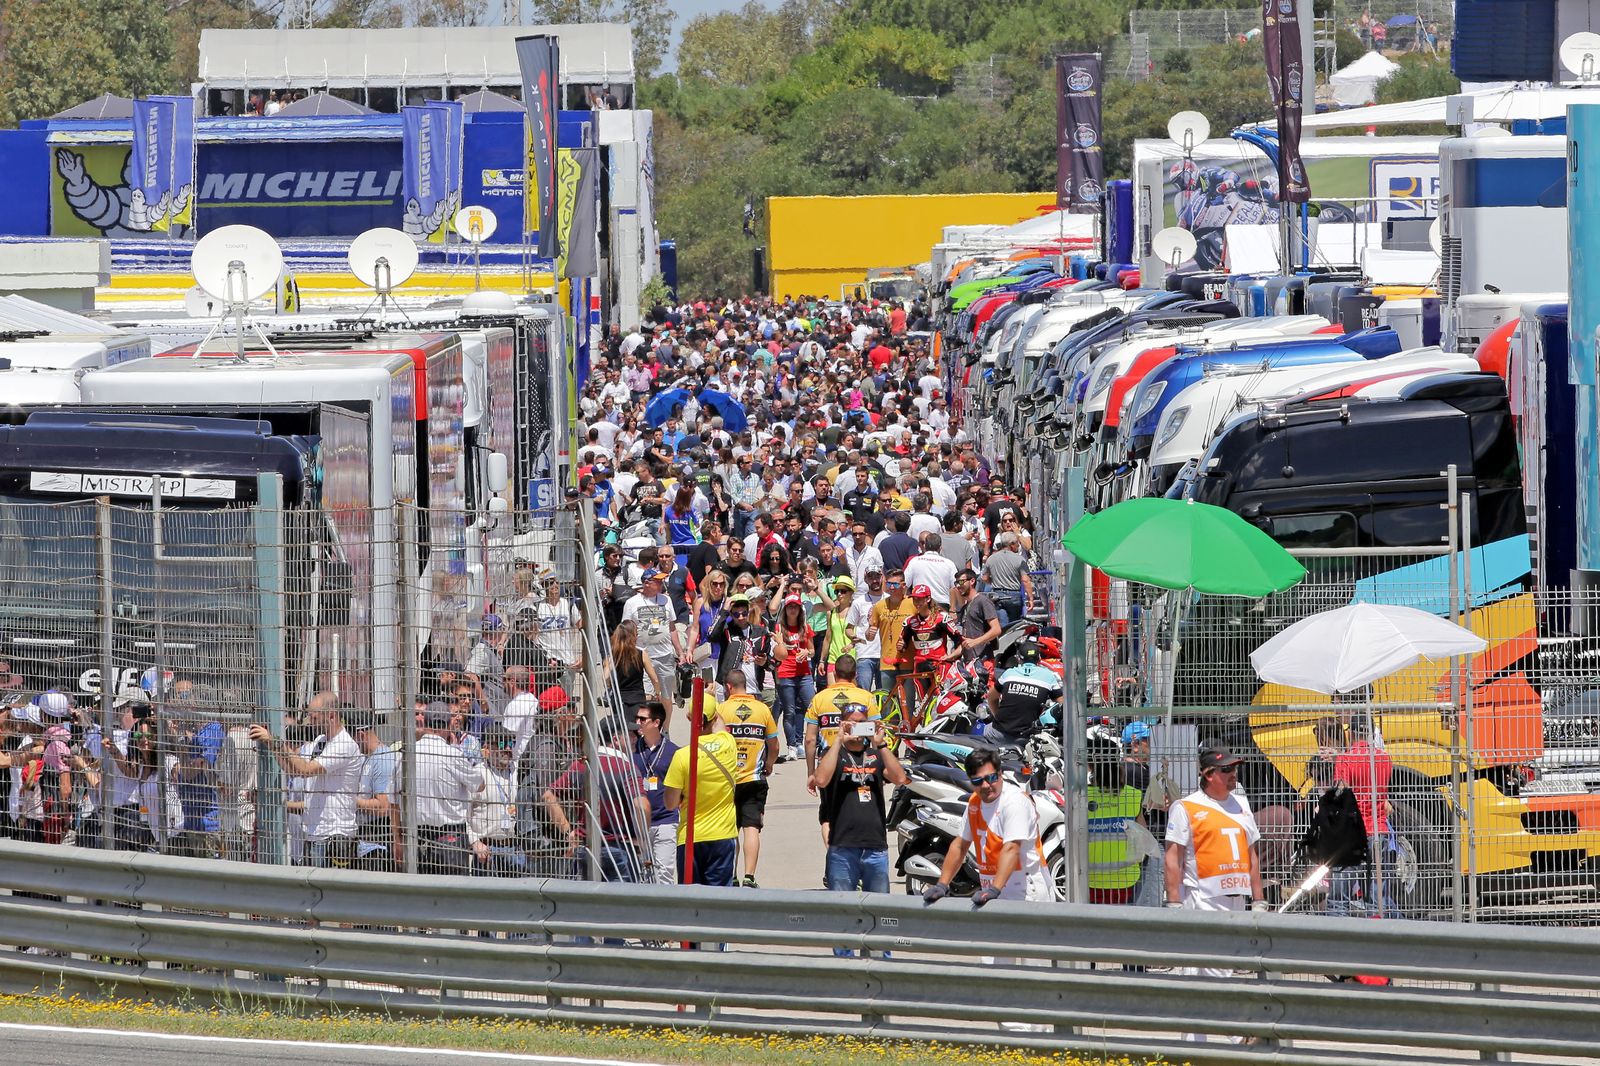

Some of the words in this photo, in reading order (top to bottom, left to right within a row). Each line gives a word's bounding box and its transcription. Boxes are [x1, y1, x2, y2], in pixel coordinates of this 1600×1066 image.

[147, 106, 159, 188] MICHELIN
[421, 113, 431, 198] MICHELIN
[199, 170, 404, 200] MICHELI
[1008, 683, 1039, 695] LEOPARD
[1221, 828, 1240, 861] T
